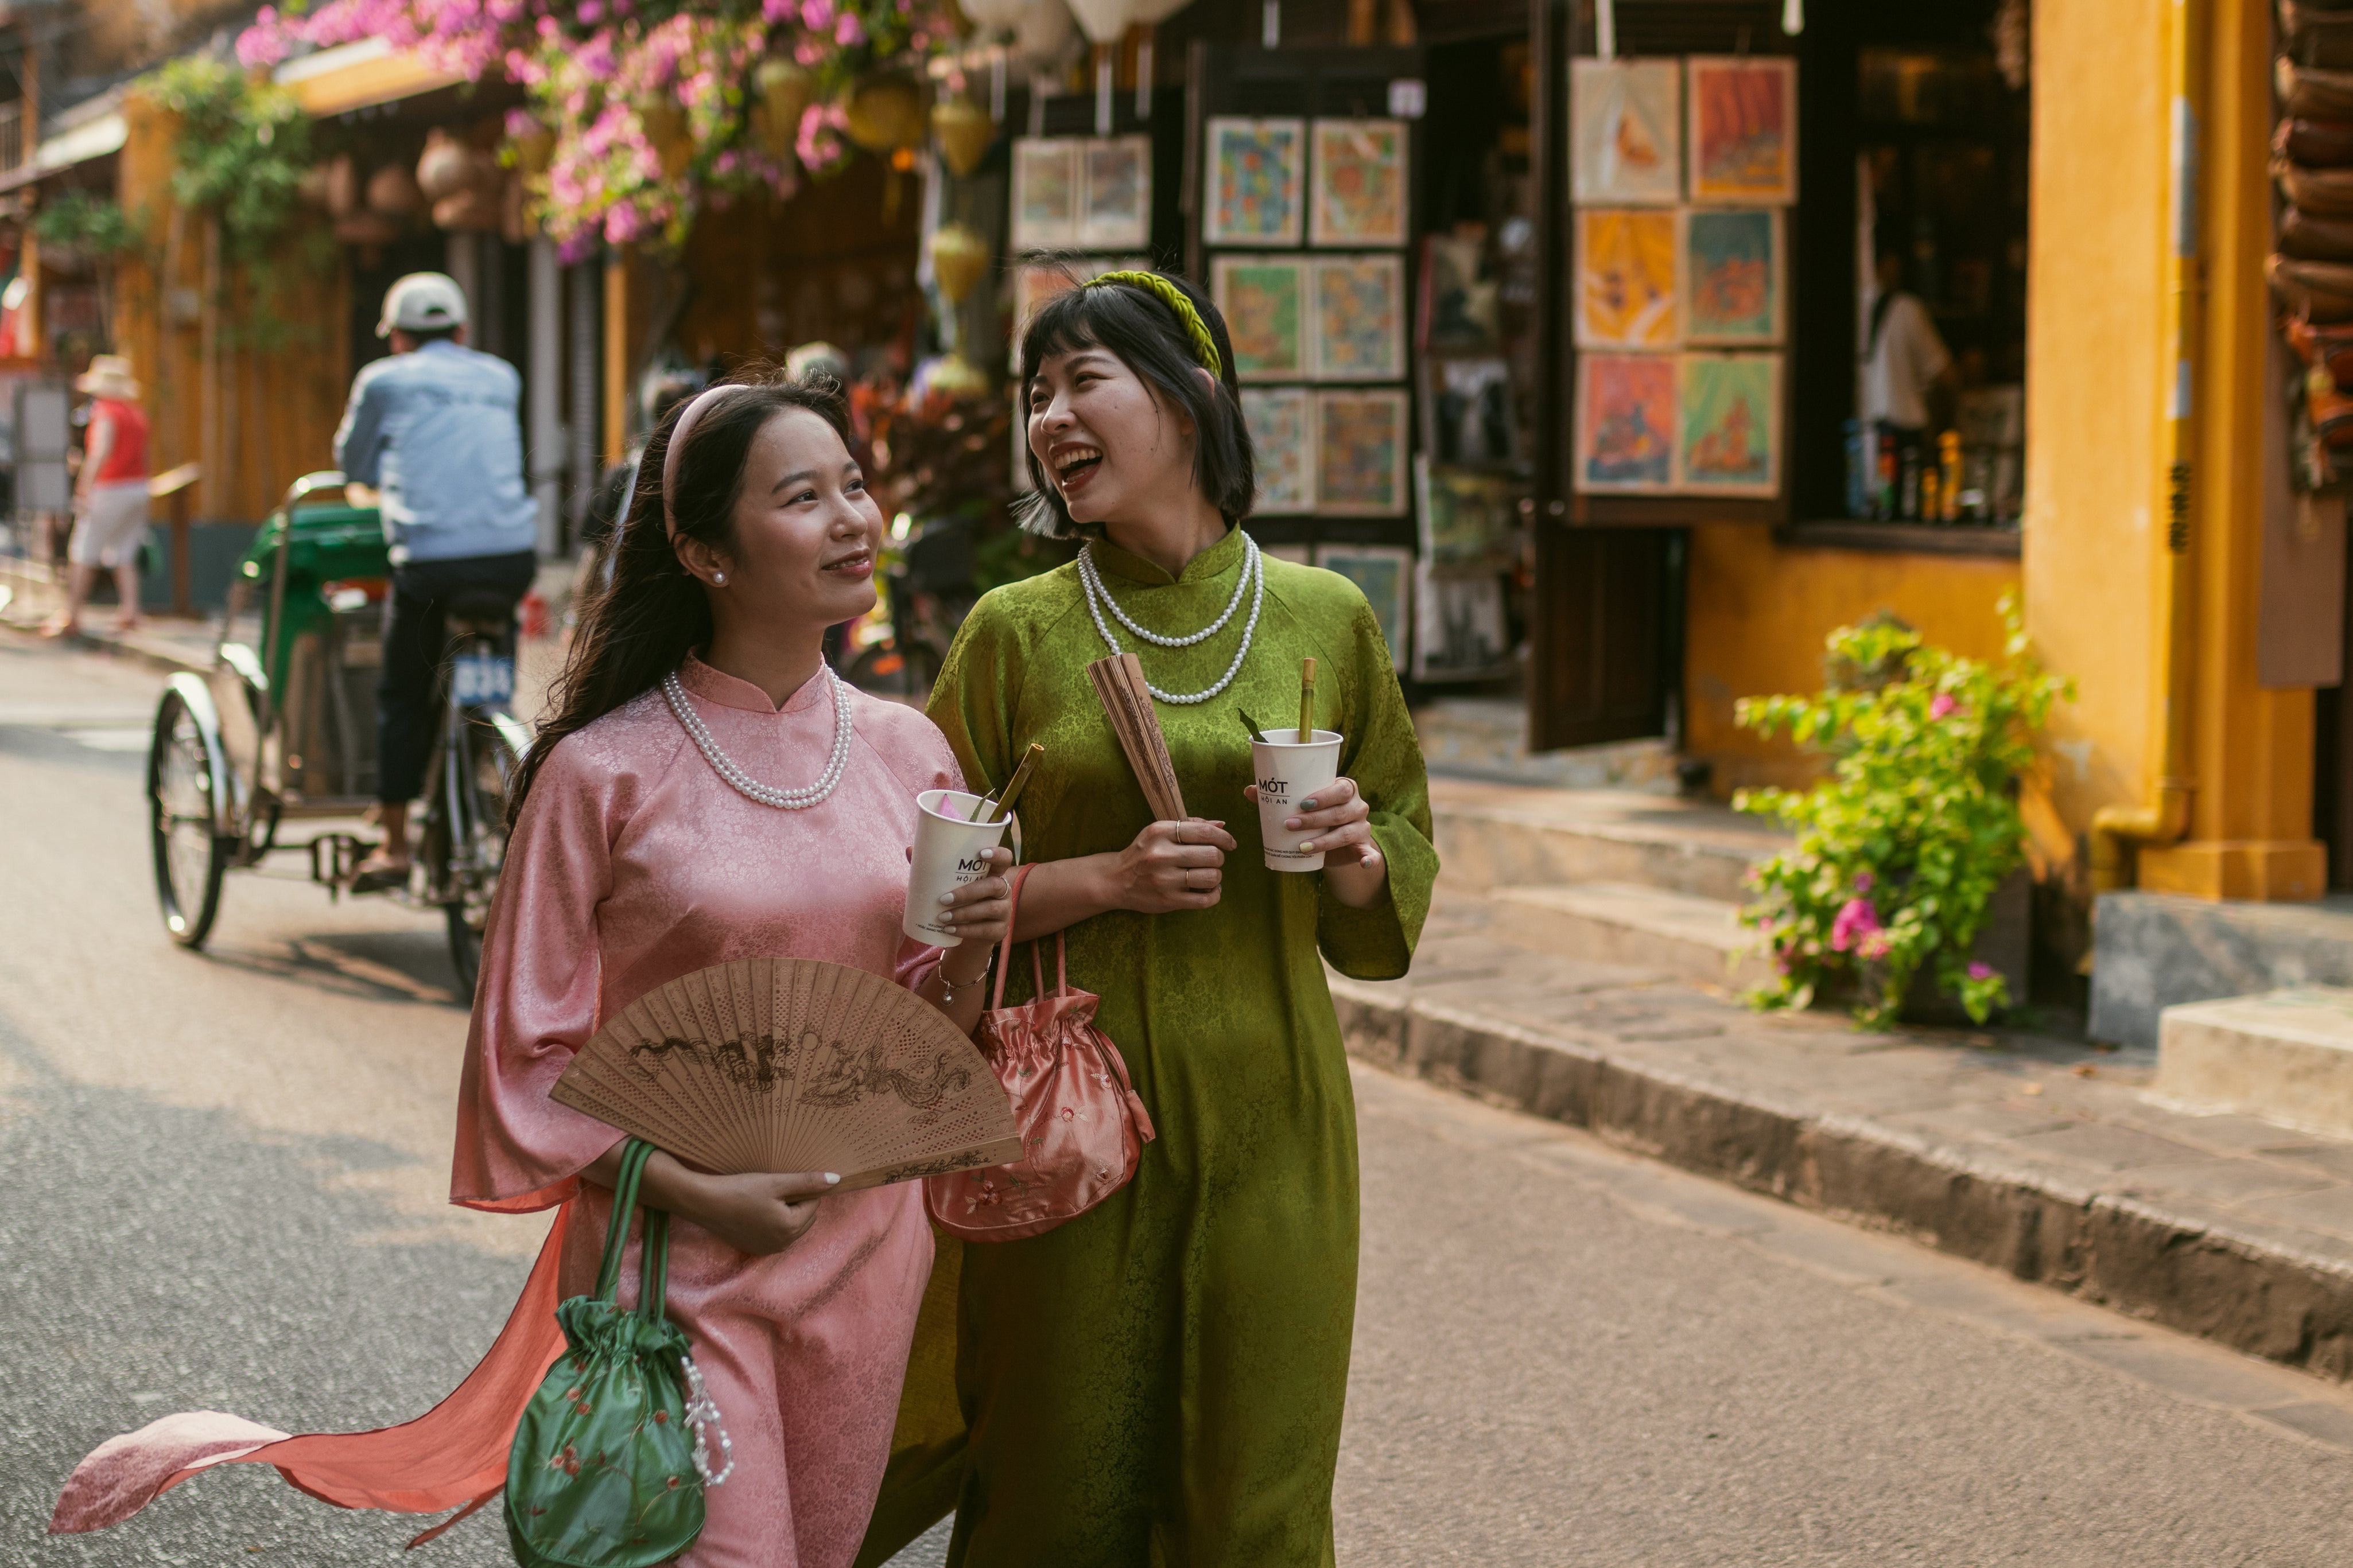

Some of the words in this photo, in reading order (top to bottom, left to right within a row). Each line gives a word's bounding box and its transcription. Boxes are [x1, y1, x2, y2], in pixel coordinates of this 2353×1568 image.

[1259, 777, 1288, 793] MÓT
[1261, 796, 1272, 804] HỘI
[956, 875, 972, 883] HỘI
